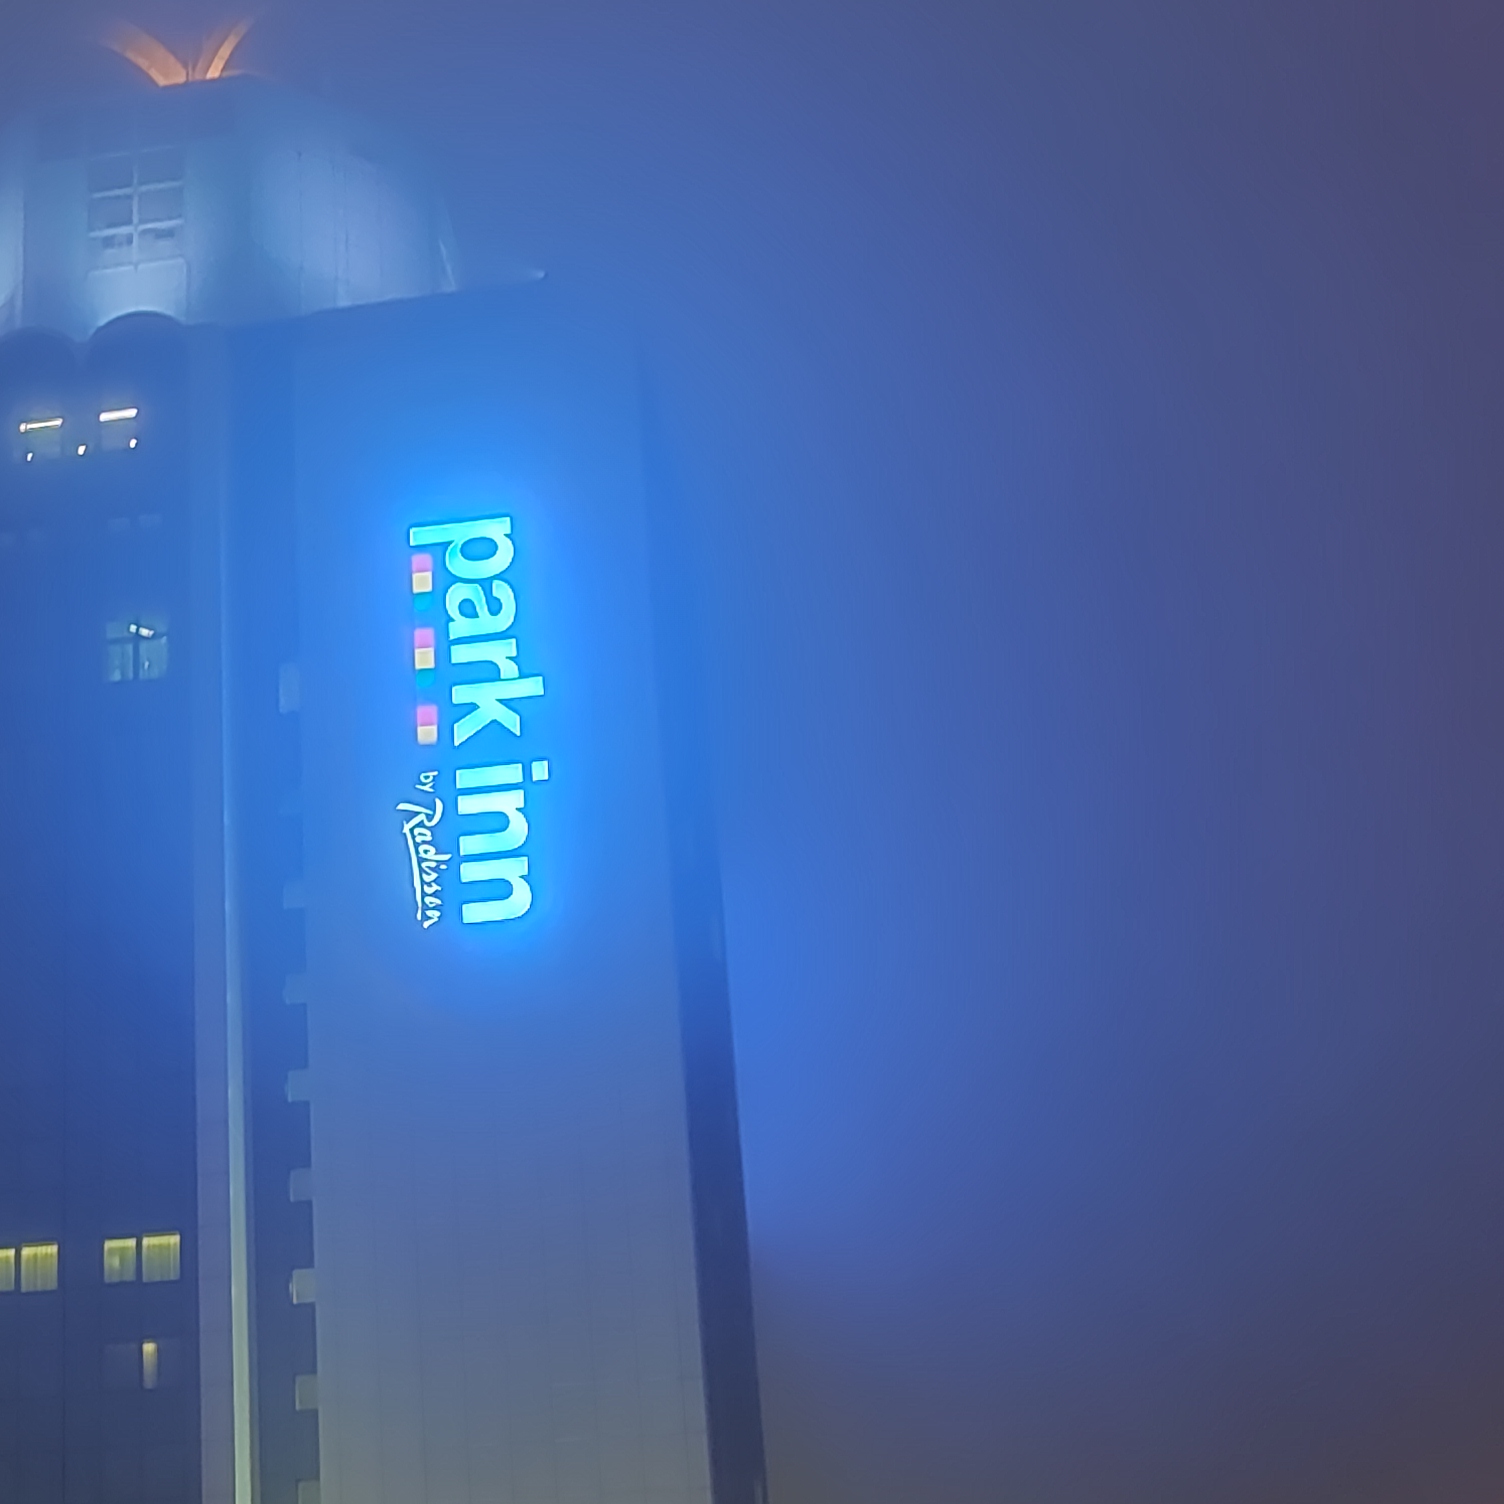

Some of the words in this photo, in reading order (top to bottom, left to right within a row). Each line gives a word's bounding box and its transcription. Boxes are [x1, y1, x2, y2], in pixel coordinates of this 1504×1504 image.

[409, 516, 544, 747] park
[414, 771, 439, 793] by
[455, 760, 549, 924] inn
[396, 797, 452, 929] Radisson
